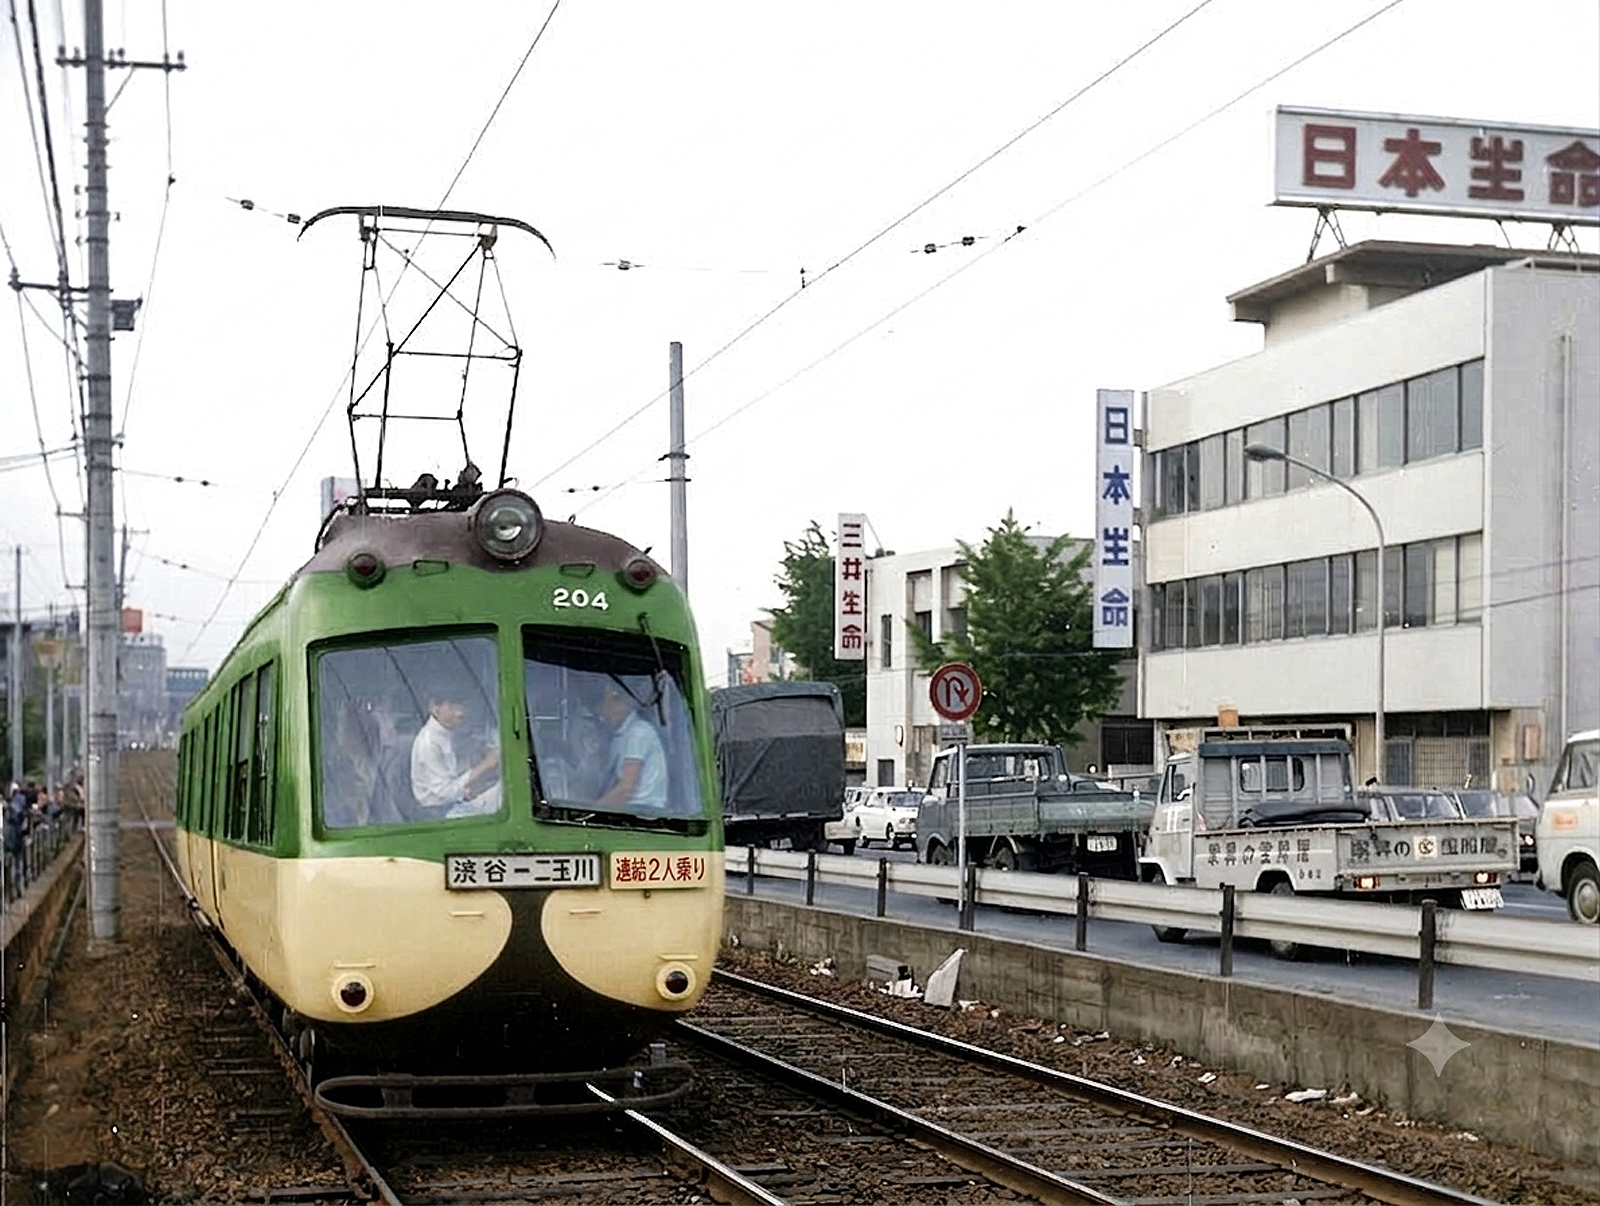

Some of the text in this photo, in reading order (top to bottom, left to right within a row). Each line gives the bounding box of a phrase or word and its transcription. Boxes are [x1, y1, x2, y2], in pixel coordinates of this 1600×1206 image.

[1302, 123, 1600, 208] 日本生命
[1101, 406, 1130, 627] 日本生命
[553, 588, 609, 611] 204
[842, 523, 862, 649] 三井生命
